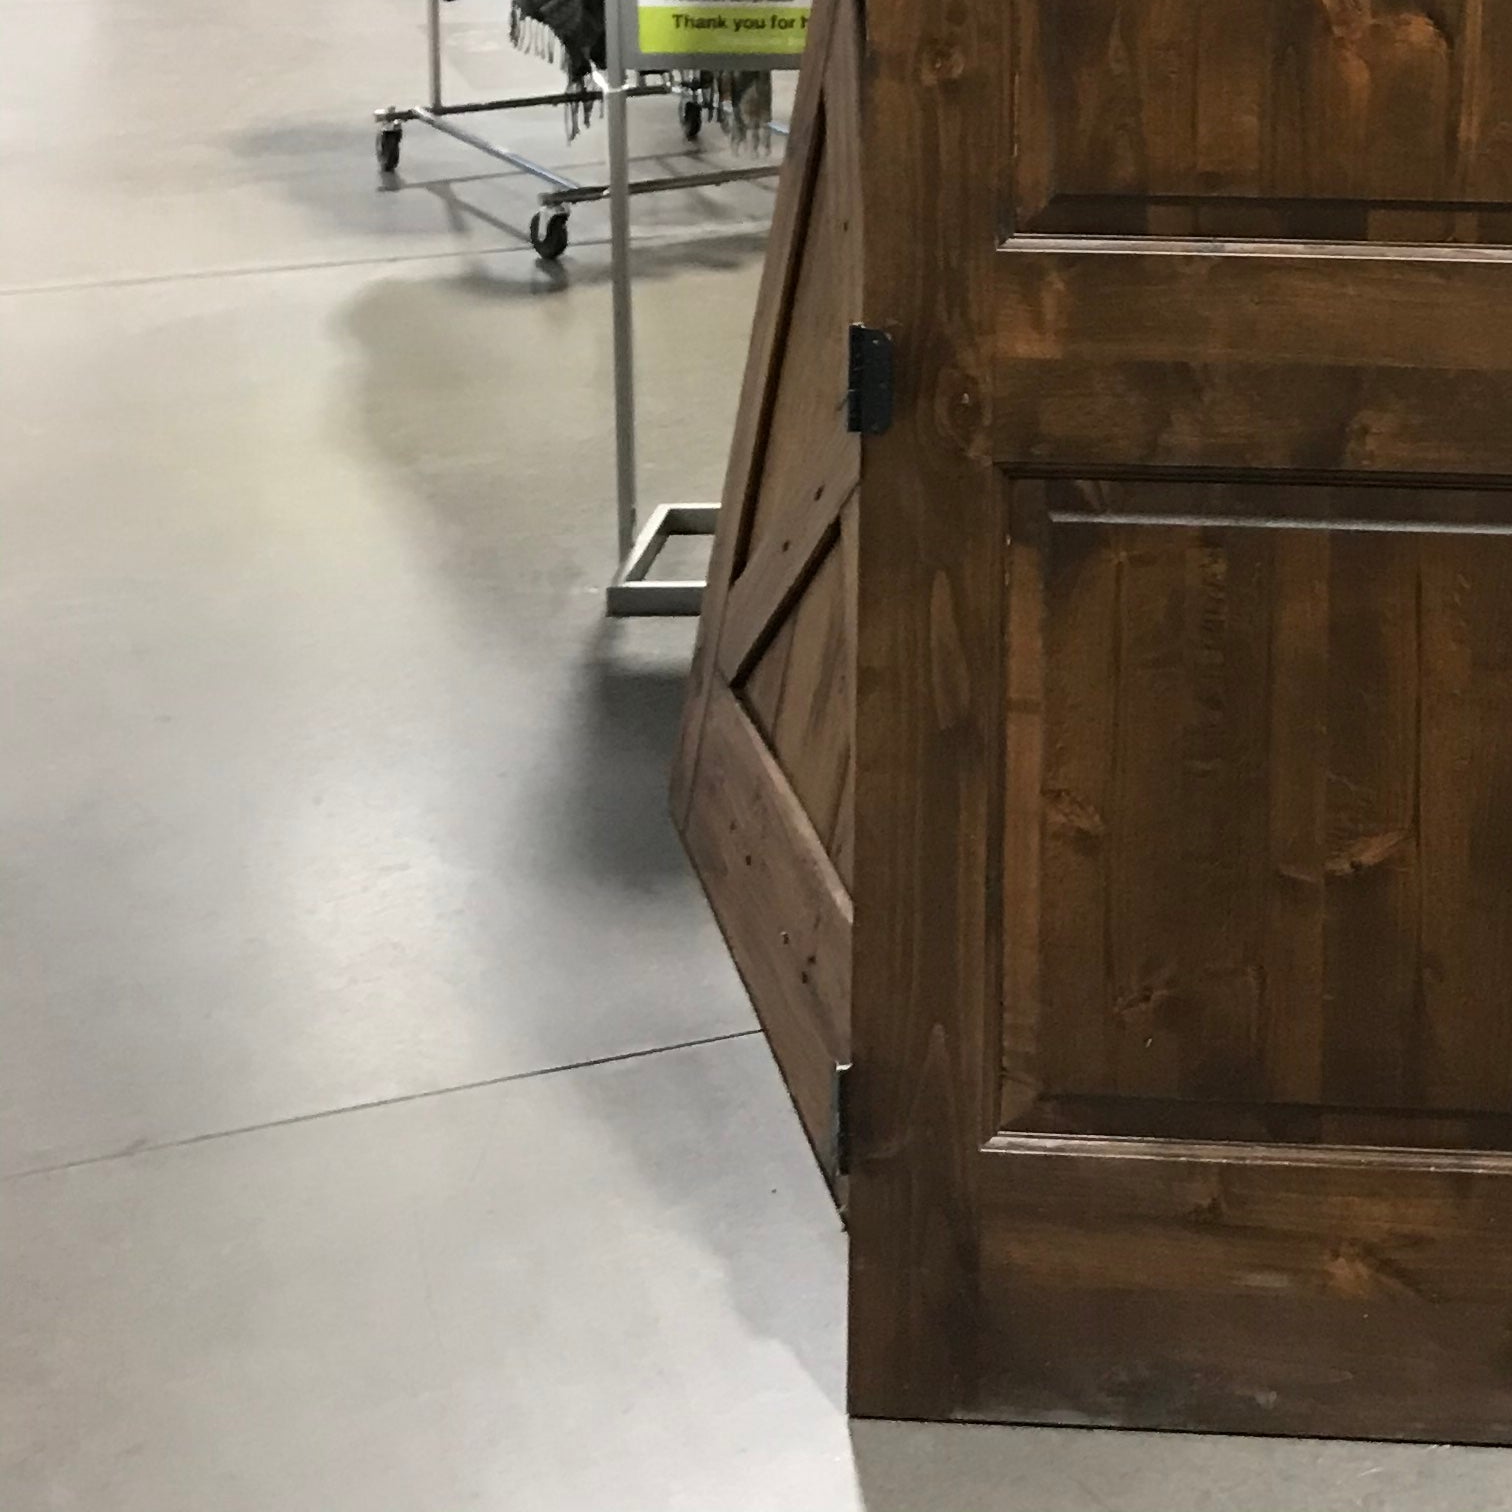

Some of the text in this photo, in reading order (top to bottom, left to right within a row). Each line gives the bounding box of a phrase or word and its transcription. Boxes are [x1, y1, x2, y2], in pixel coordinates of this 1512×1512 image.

[672, 13, 726, 30] Thank
[733, 15, 766, 32] you
[770, 14, 796, 29] for
